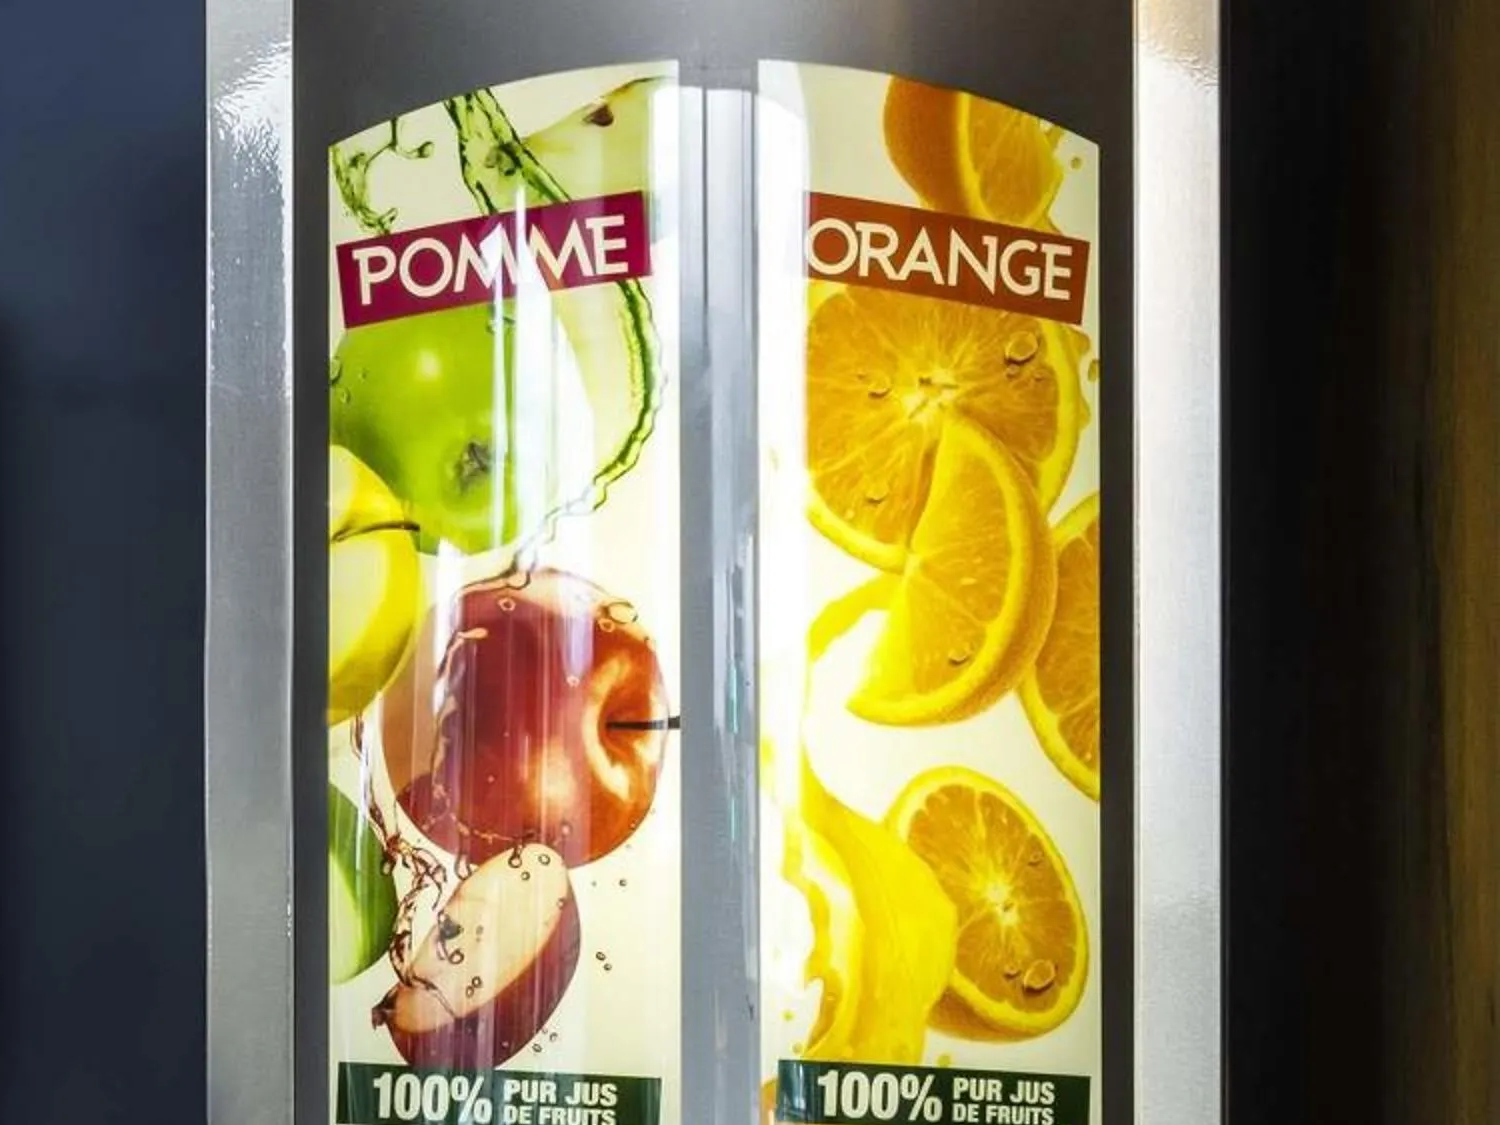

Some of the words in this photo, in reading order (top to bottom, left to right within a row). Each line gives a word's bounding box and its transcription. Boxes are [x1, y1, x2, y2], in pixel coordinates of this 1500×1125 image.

[351, 213, 629, 306] POMME
[804, 217, 1073, 301] ORANGE
[373, 1071, 493, 1125] 100%
[503, 1079, 557, 1105] PUR
[565, 1082, 618, 1107] JUS
[817, 1070, 943, 1123] 100%
[952, 1077, 1003, 1102] PUR
[1009, 1080, 1056, 1105] JUS
[501, 1105, 532, 1125] DE
[952, 1103, 979, 1123] DE
